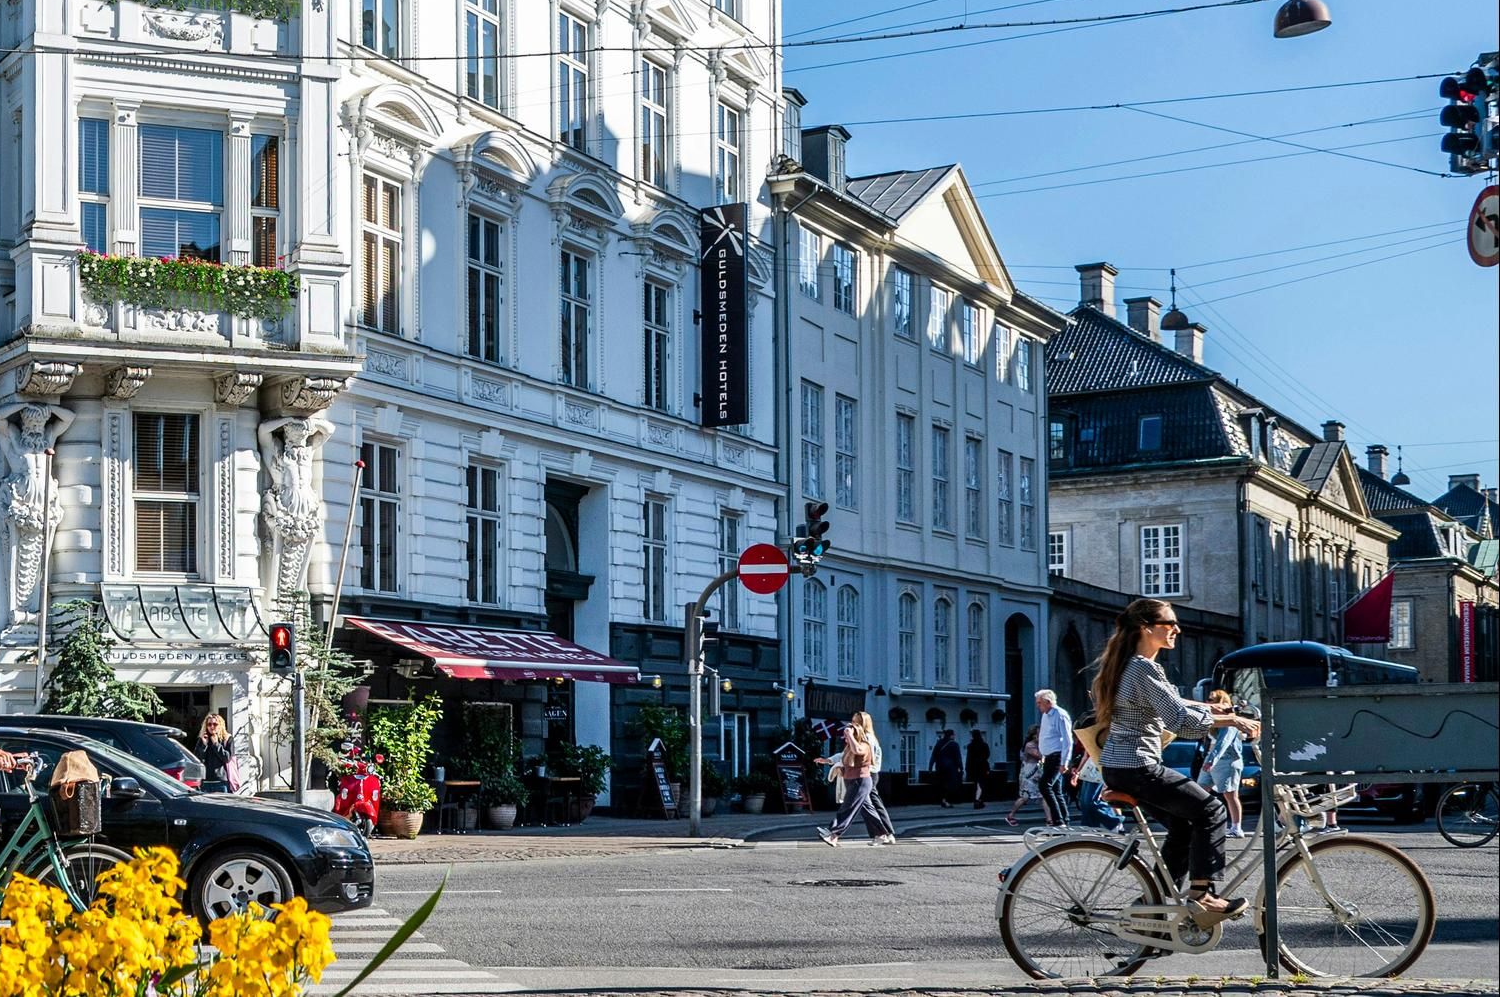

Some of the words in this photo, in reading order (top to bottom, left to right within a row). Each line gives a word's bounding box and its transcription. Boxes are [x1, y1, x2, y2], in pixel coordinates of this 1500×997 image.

[718, 248, 728, 354] GULDSMEDEN
[718, 359, 728, 420] HOTELS
[102, 652, 193, 660] GULDSMEDEN
[198, 652, 248, 661] HOTELS
[358, 621, 582, 652] BABETTE
